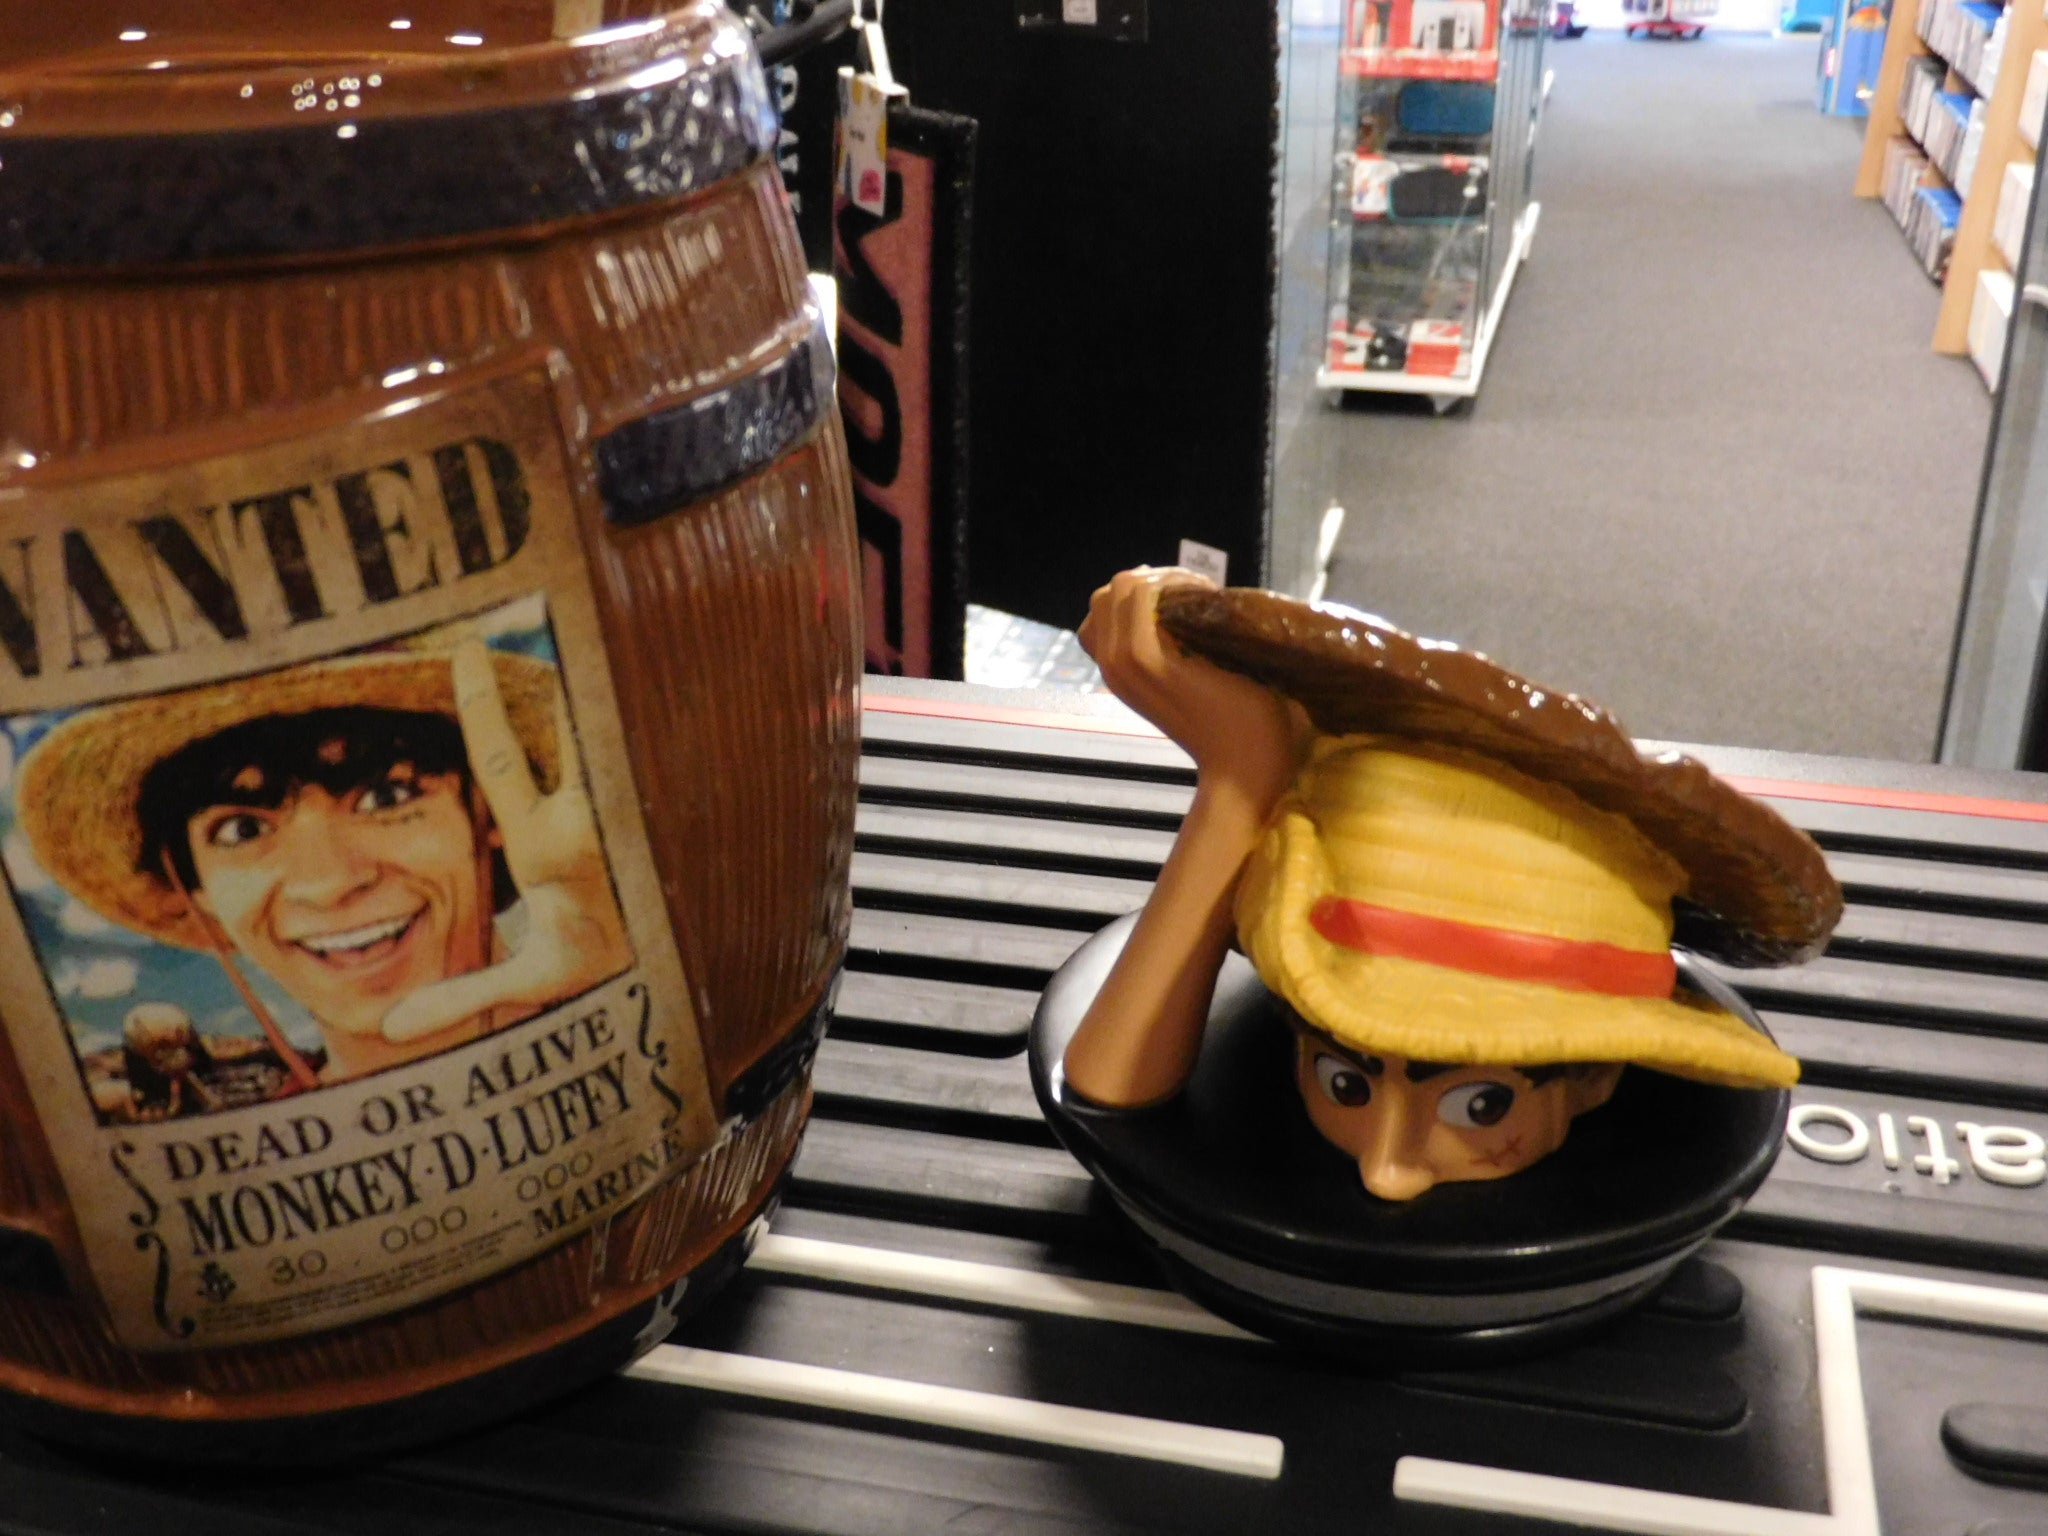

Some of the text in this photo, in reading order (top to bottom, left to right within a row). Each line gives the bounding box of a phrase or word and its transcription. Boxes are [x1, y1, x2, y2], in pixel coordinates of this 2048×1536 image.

[159, 1007, 617, 1183] DEAD OR ALIVE
[531, 1127, 687, 1240] MARINE
